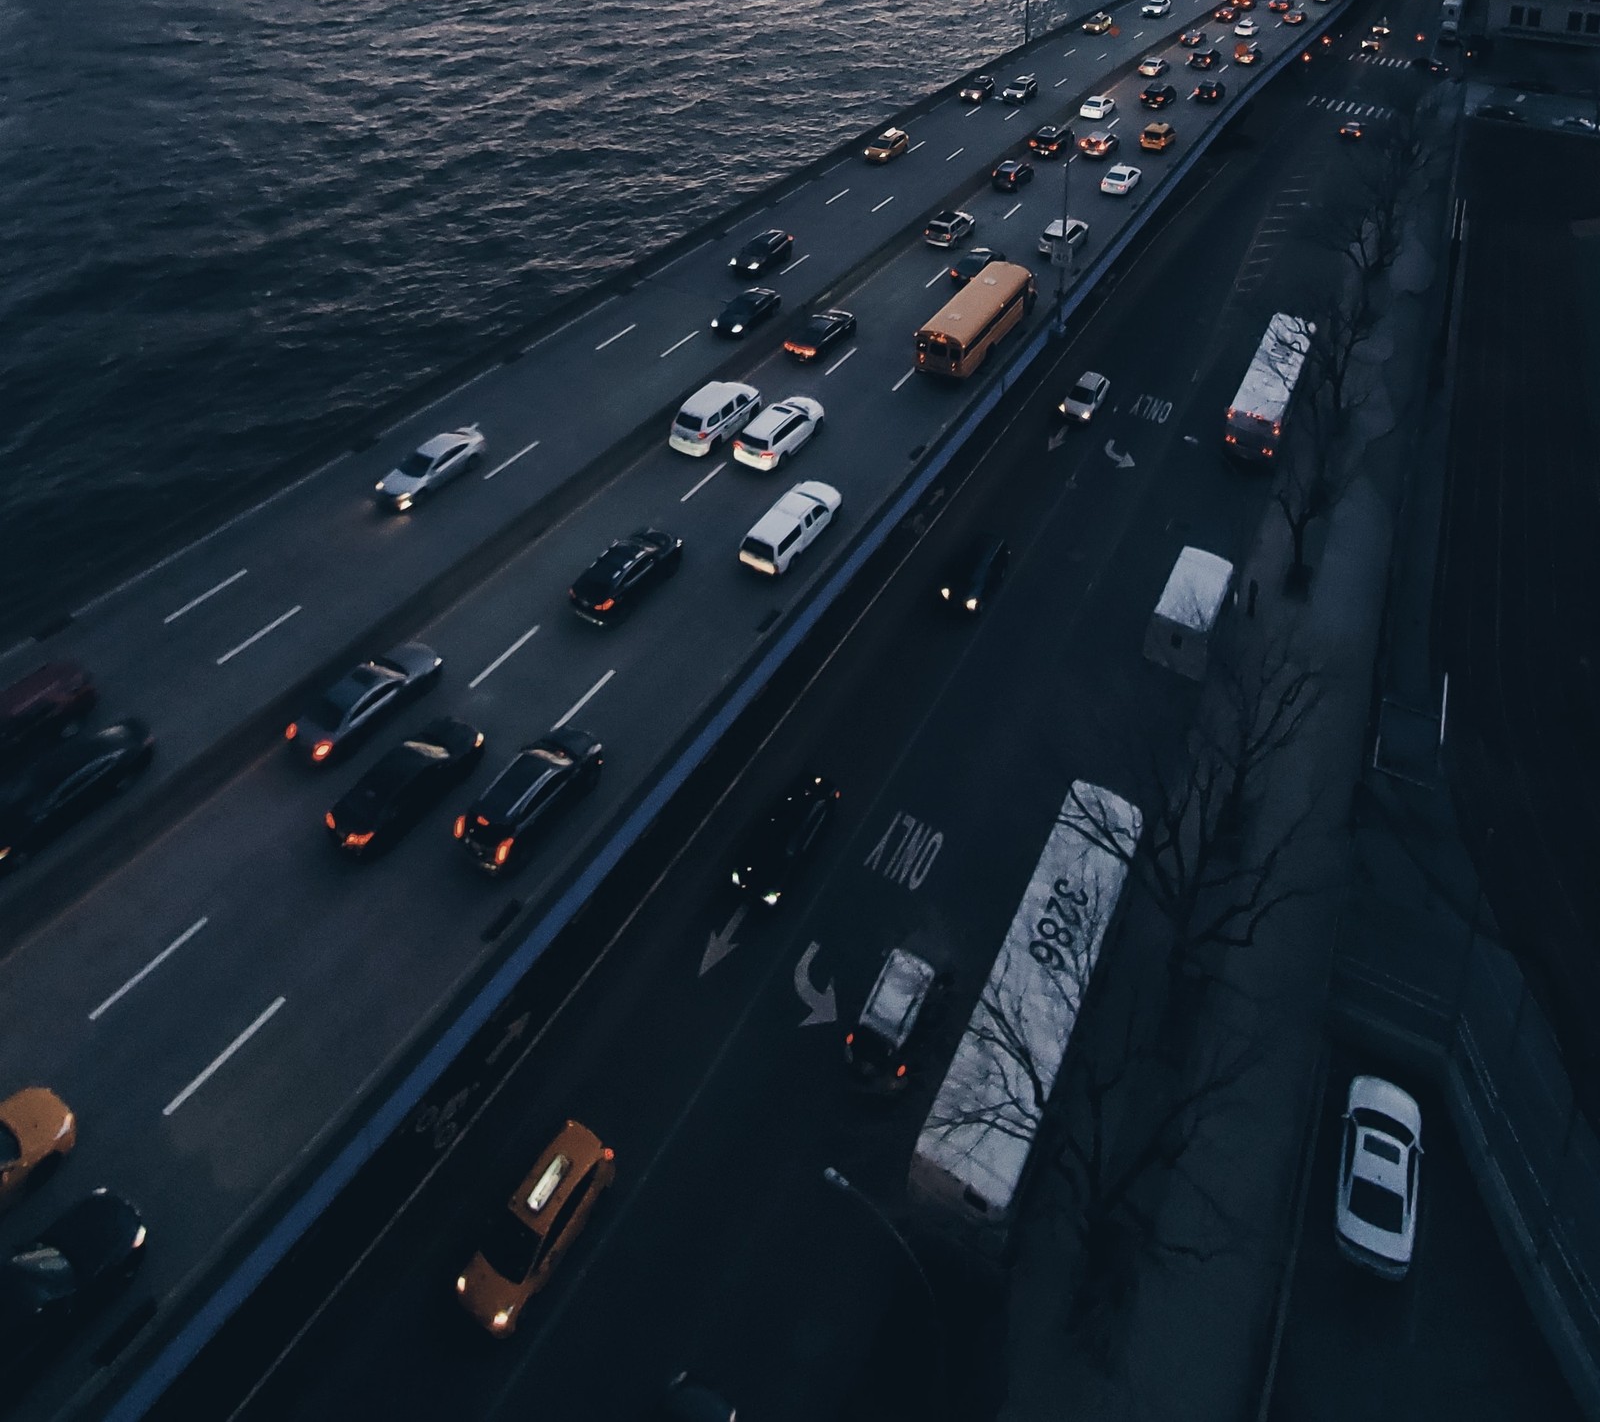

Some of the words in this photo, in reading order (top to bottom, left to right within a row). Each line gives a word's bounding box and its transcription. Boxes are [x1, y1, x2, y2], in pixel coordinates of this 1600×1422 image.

[1129, 393, 1173, 423] ONLY
[863, 810, 945, 891] ONLY
[1027, 877, 1089, 973] 3286
